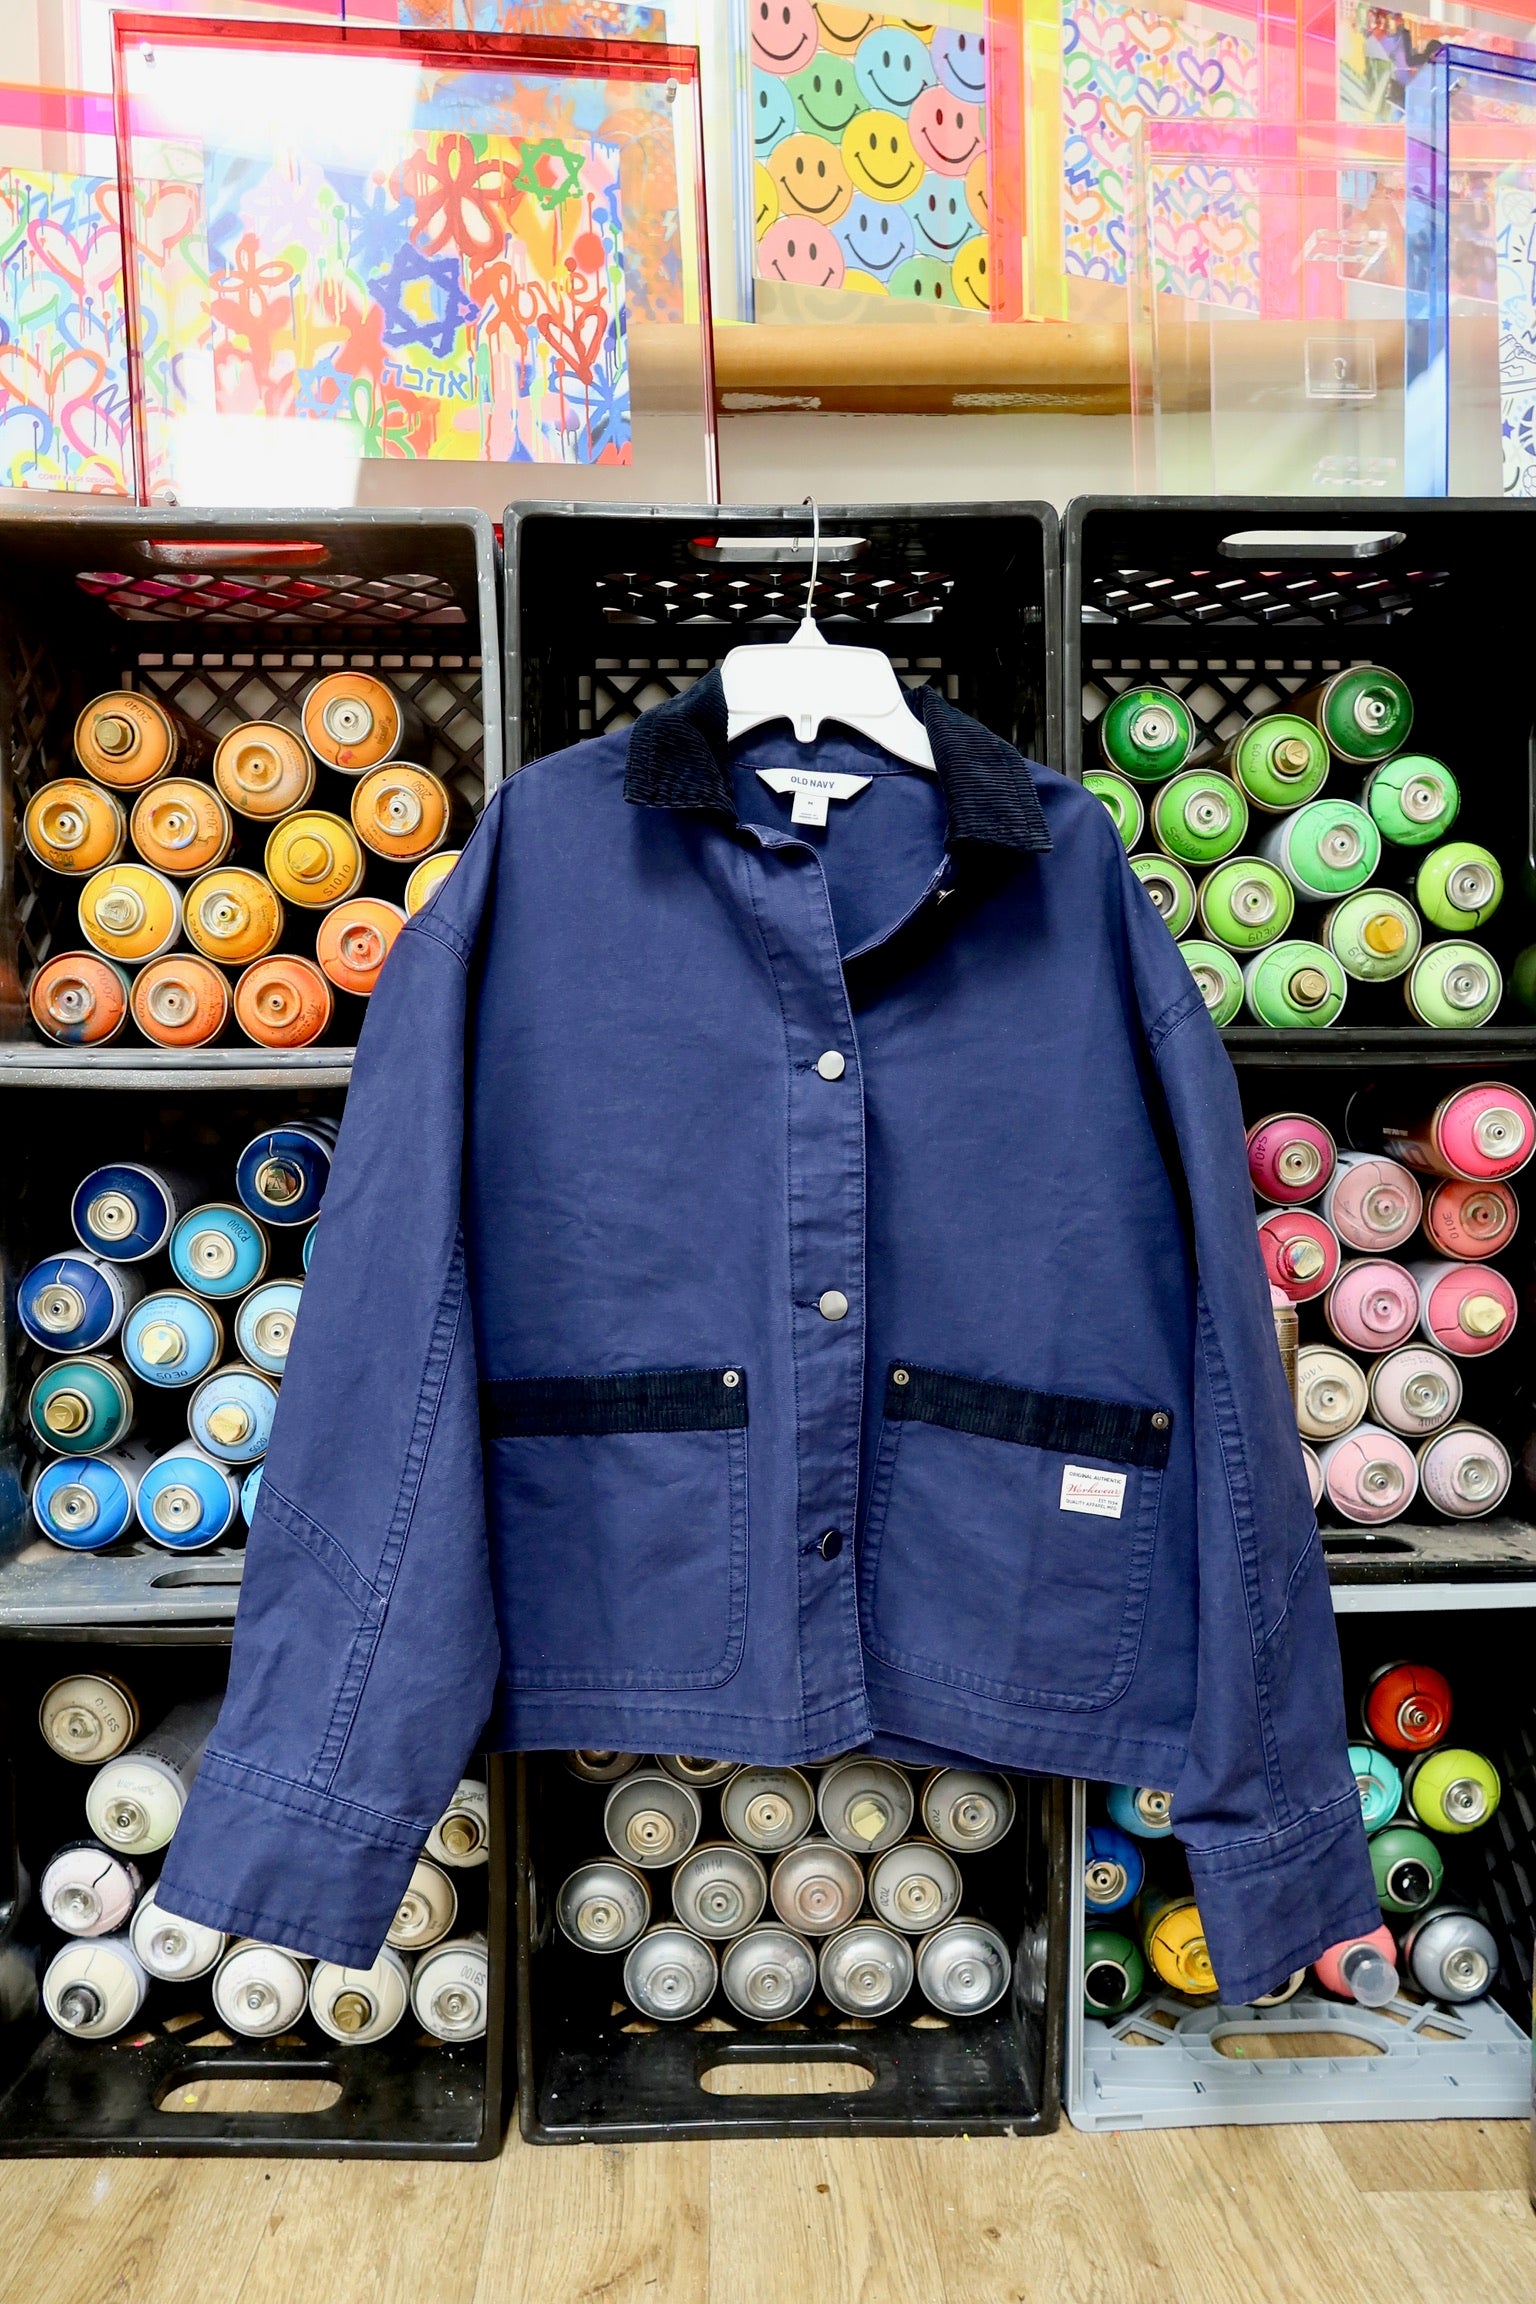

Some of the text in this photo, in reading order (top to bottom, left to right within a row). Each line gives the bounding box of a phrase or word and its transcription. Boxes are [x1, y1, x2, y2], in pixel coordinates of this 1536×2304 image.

[124, 700, 152, 723] 2040
[412, 781, 432, 799] 2050
[791, 776, 835, 789] OLD NAVY
[323, 864, 351, 896] S1010
[1247, 926, 1276, 943] 6030
[227, 1219, 251, 1242] P2000
[1442, 1212, 1458, 1240] 3010
[1069, 1471, 1122, 1485] ORIGINAL AUTHENTIC
[1066, 1482, 1121, 1495] Workwear
